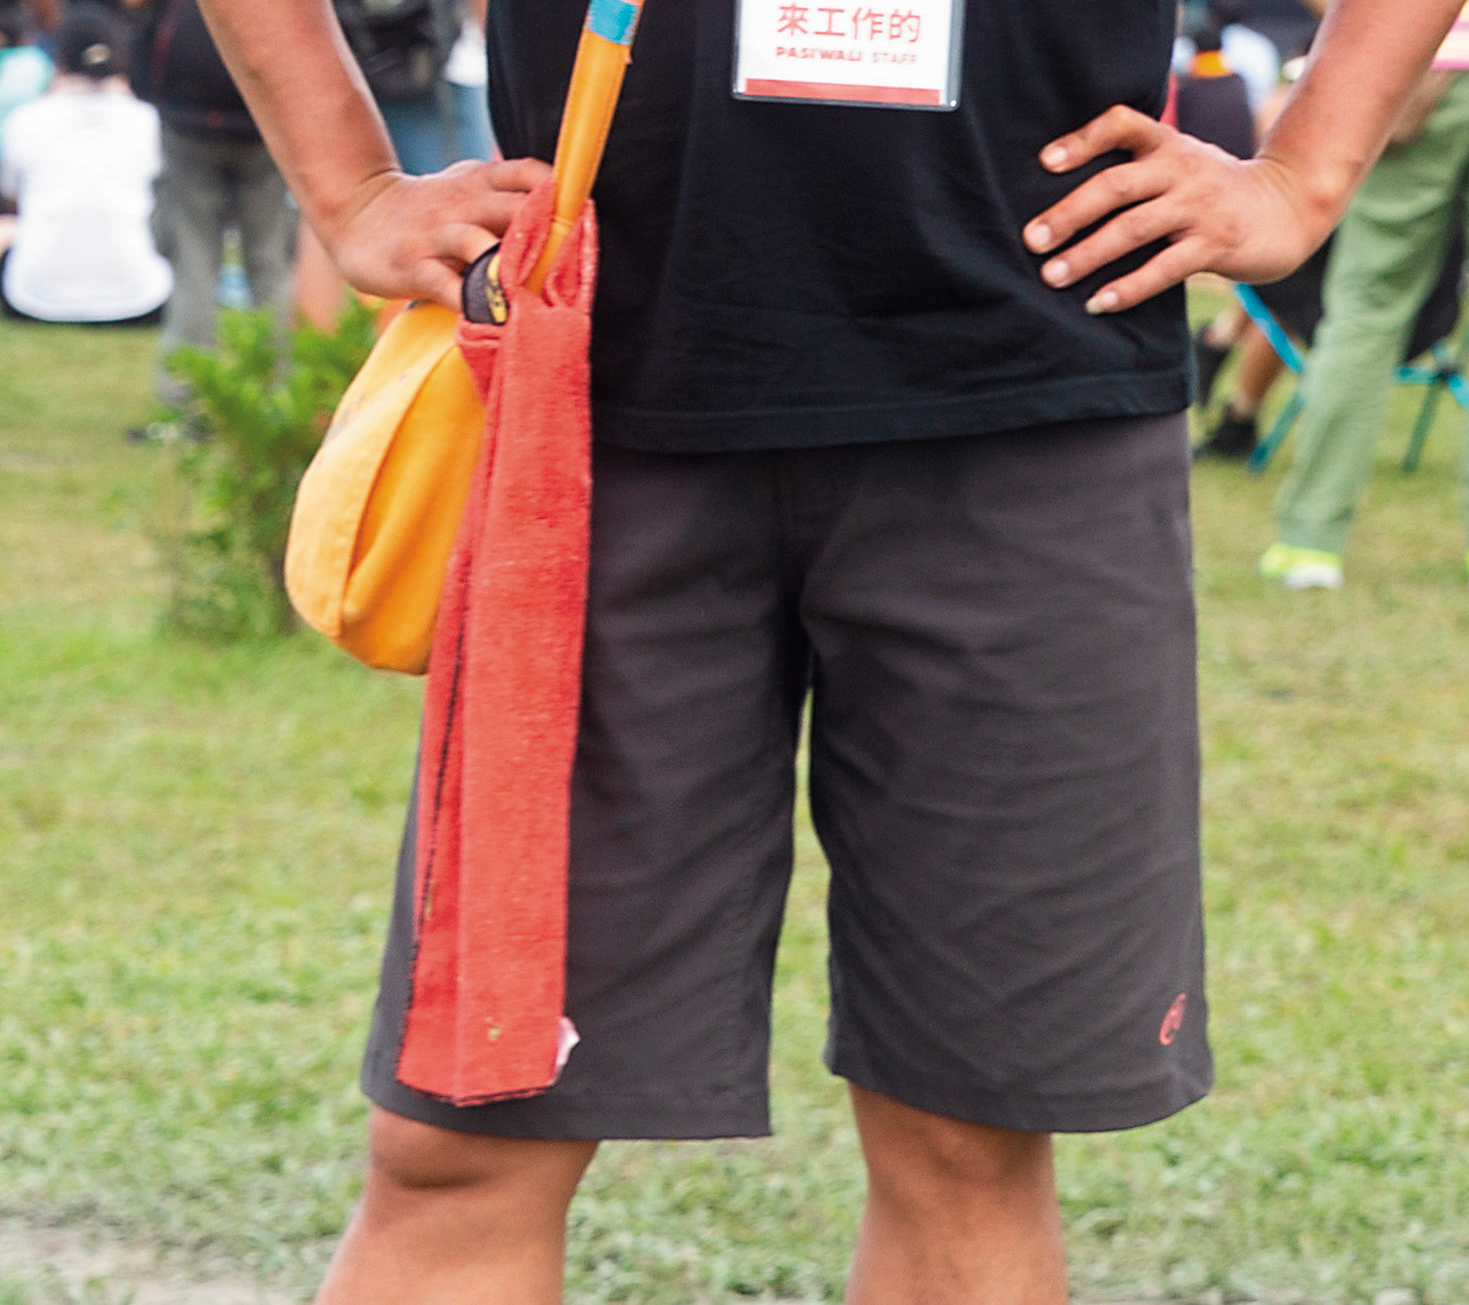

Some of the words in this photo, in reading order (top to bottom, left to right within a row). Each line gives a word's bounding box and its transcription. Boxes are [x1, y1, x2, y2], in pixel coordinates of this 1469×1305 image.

[777, 2, 921, 43] 來工作的
[872, 51, 918, 64] STAFF
